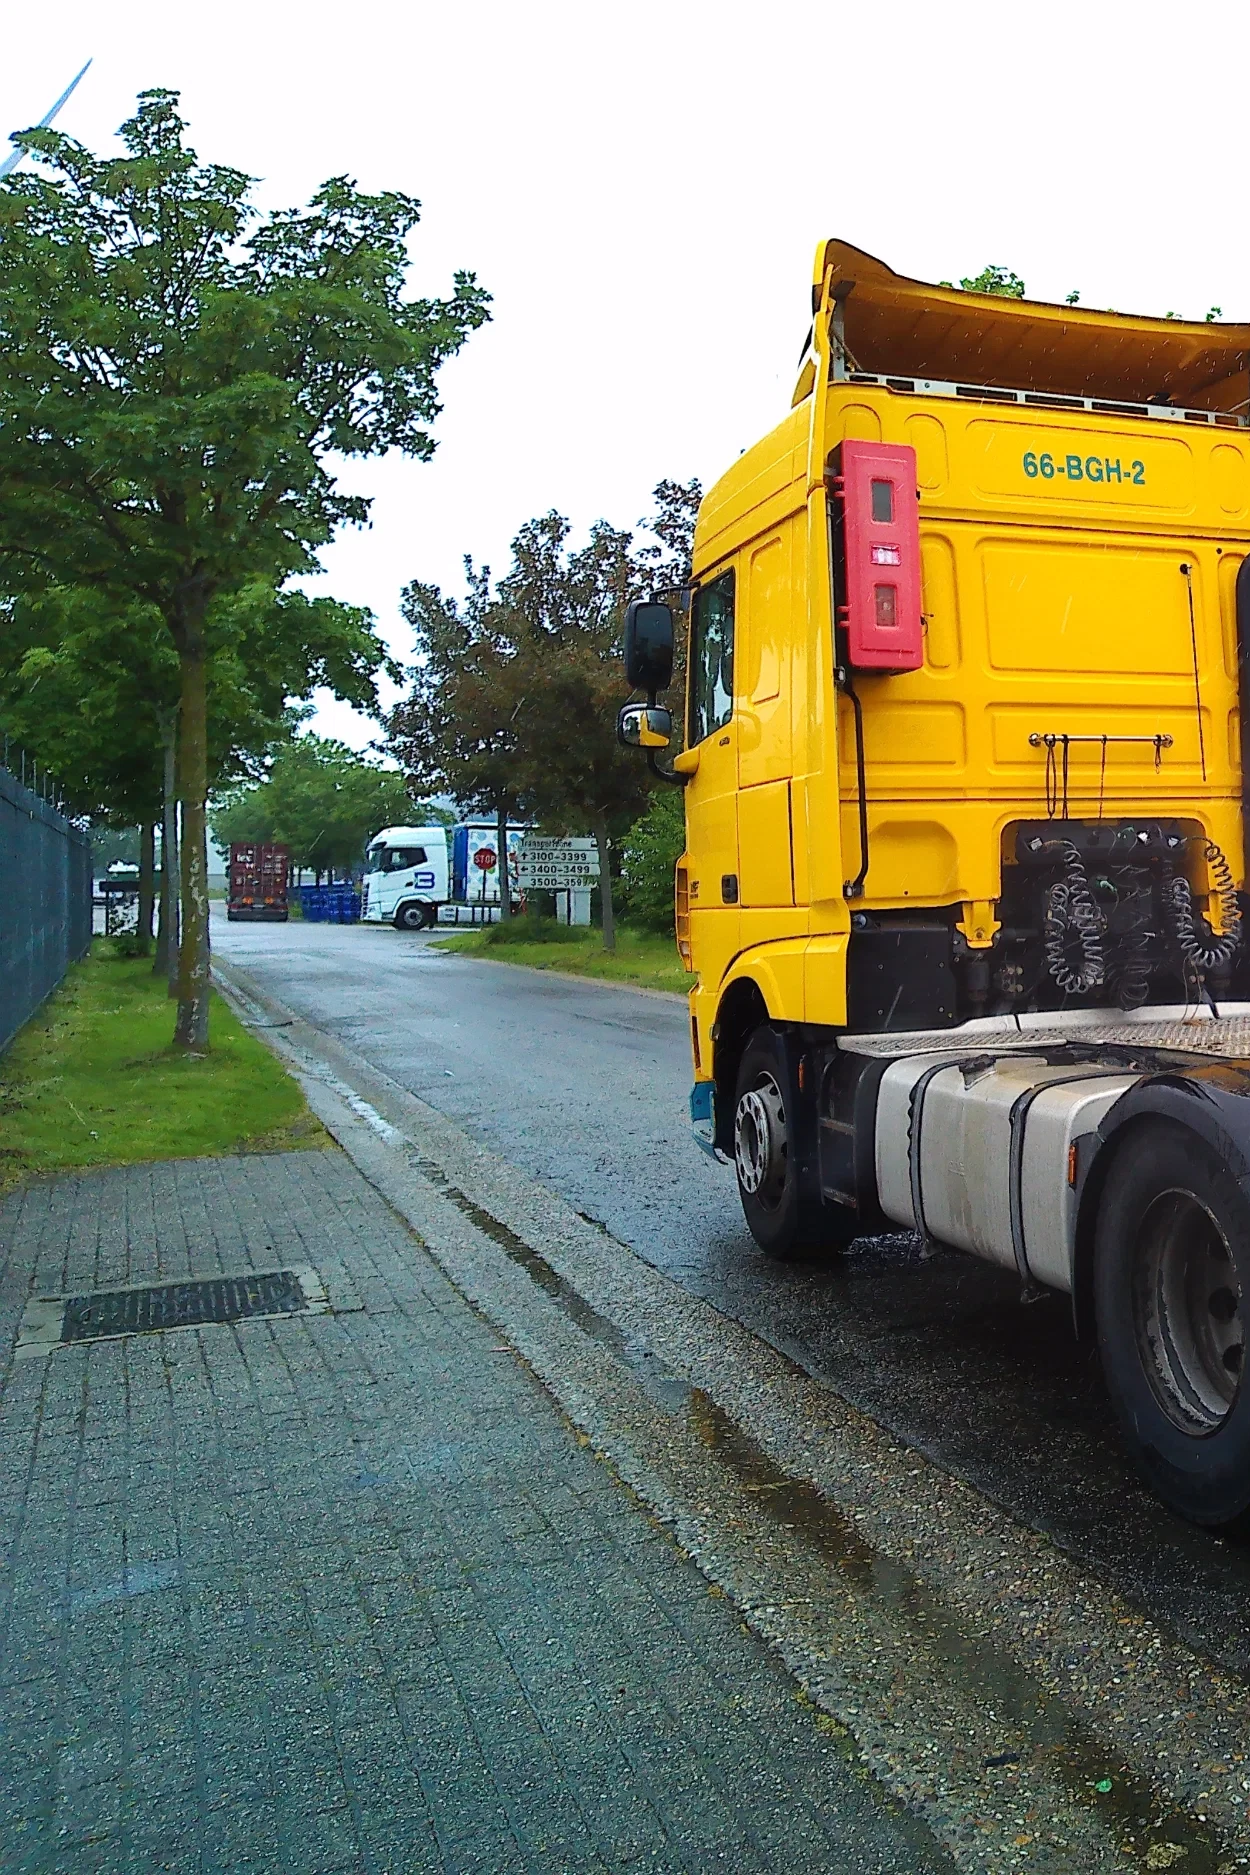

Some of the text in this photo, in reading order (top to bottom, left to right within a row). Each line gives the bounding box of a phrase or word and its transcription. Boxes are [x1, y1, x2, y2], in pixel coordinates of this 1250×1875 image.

[1023, 452, 1145, 485] 66-BGH-2
[474, 855, 497, 864] STOP
[530, 852, 587, 861] 3100-3399
[530, 865, 590, 874] 3400-3499
